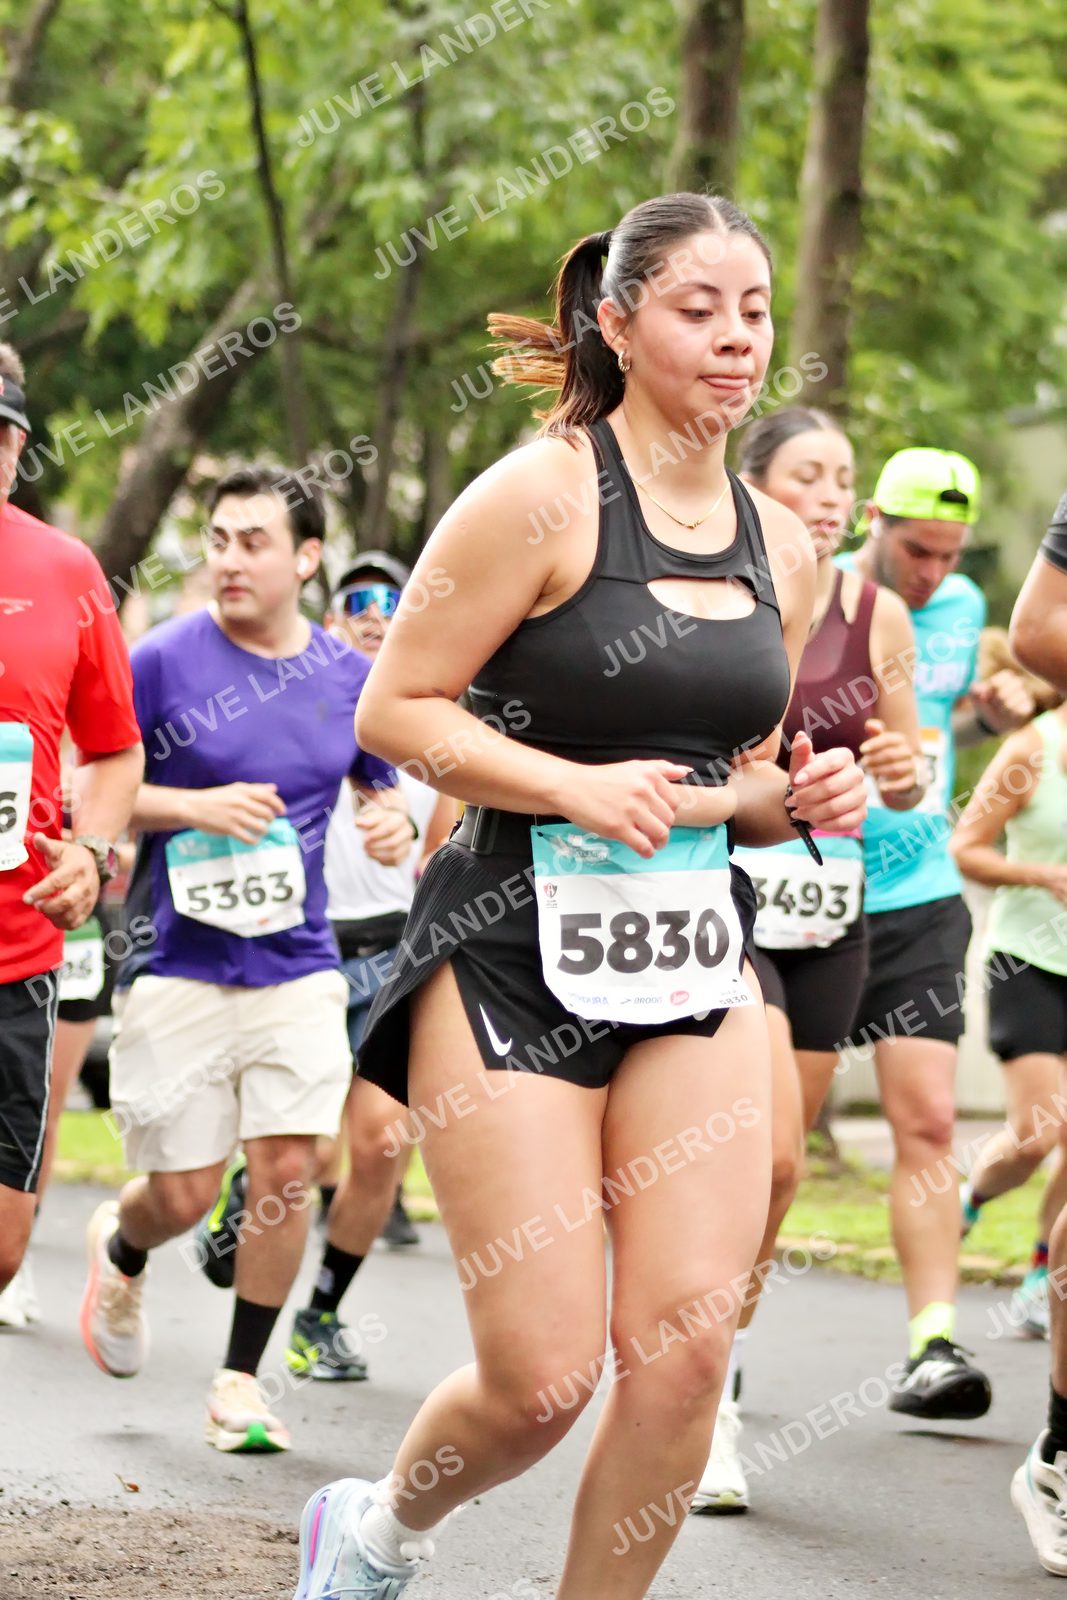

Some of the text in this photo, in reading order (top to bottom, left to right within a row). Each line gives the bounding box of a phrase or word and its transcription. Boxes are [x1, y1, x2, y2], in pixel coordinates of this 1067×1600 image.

[187, 871, 293, 912] 5363
[751, 877, 849, 919] 3493
[557, 908, 729, 975] 5830
